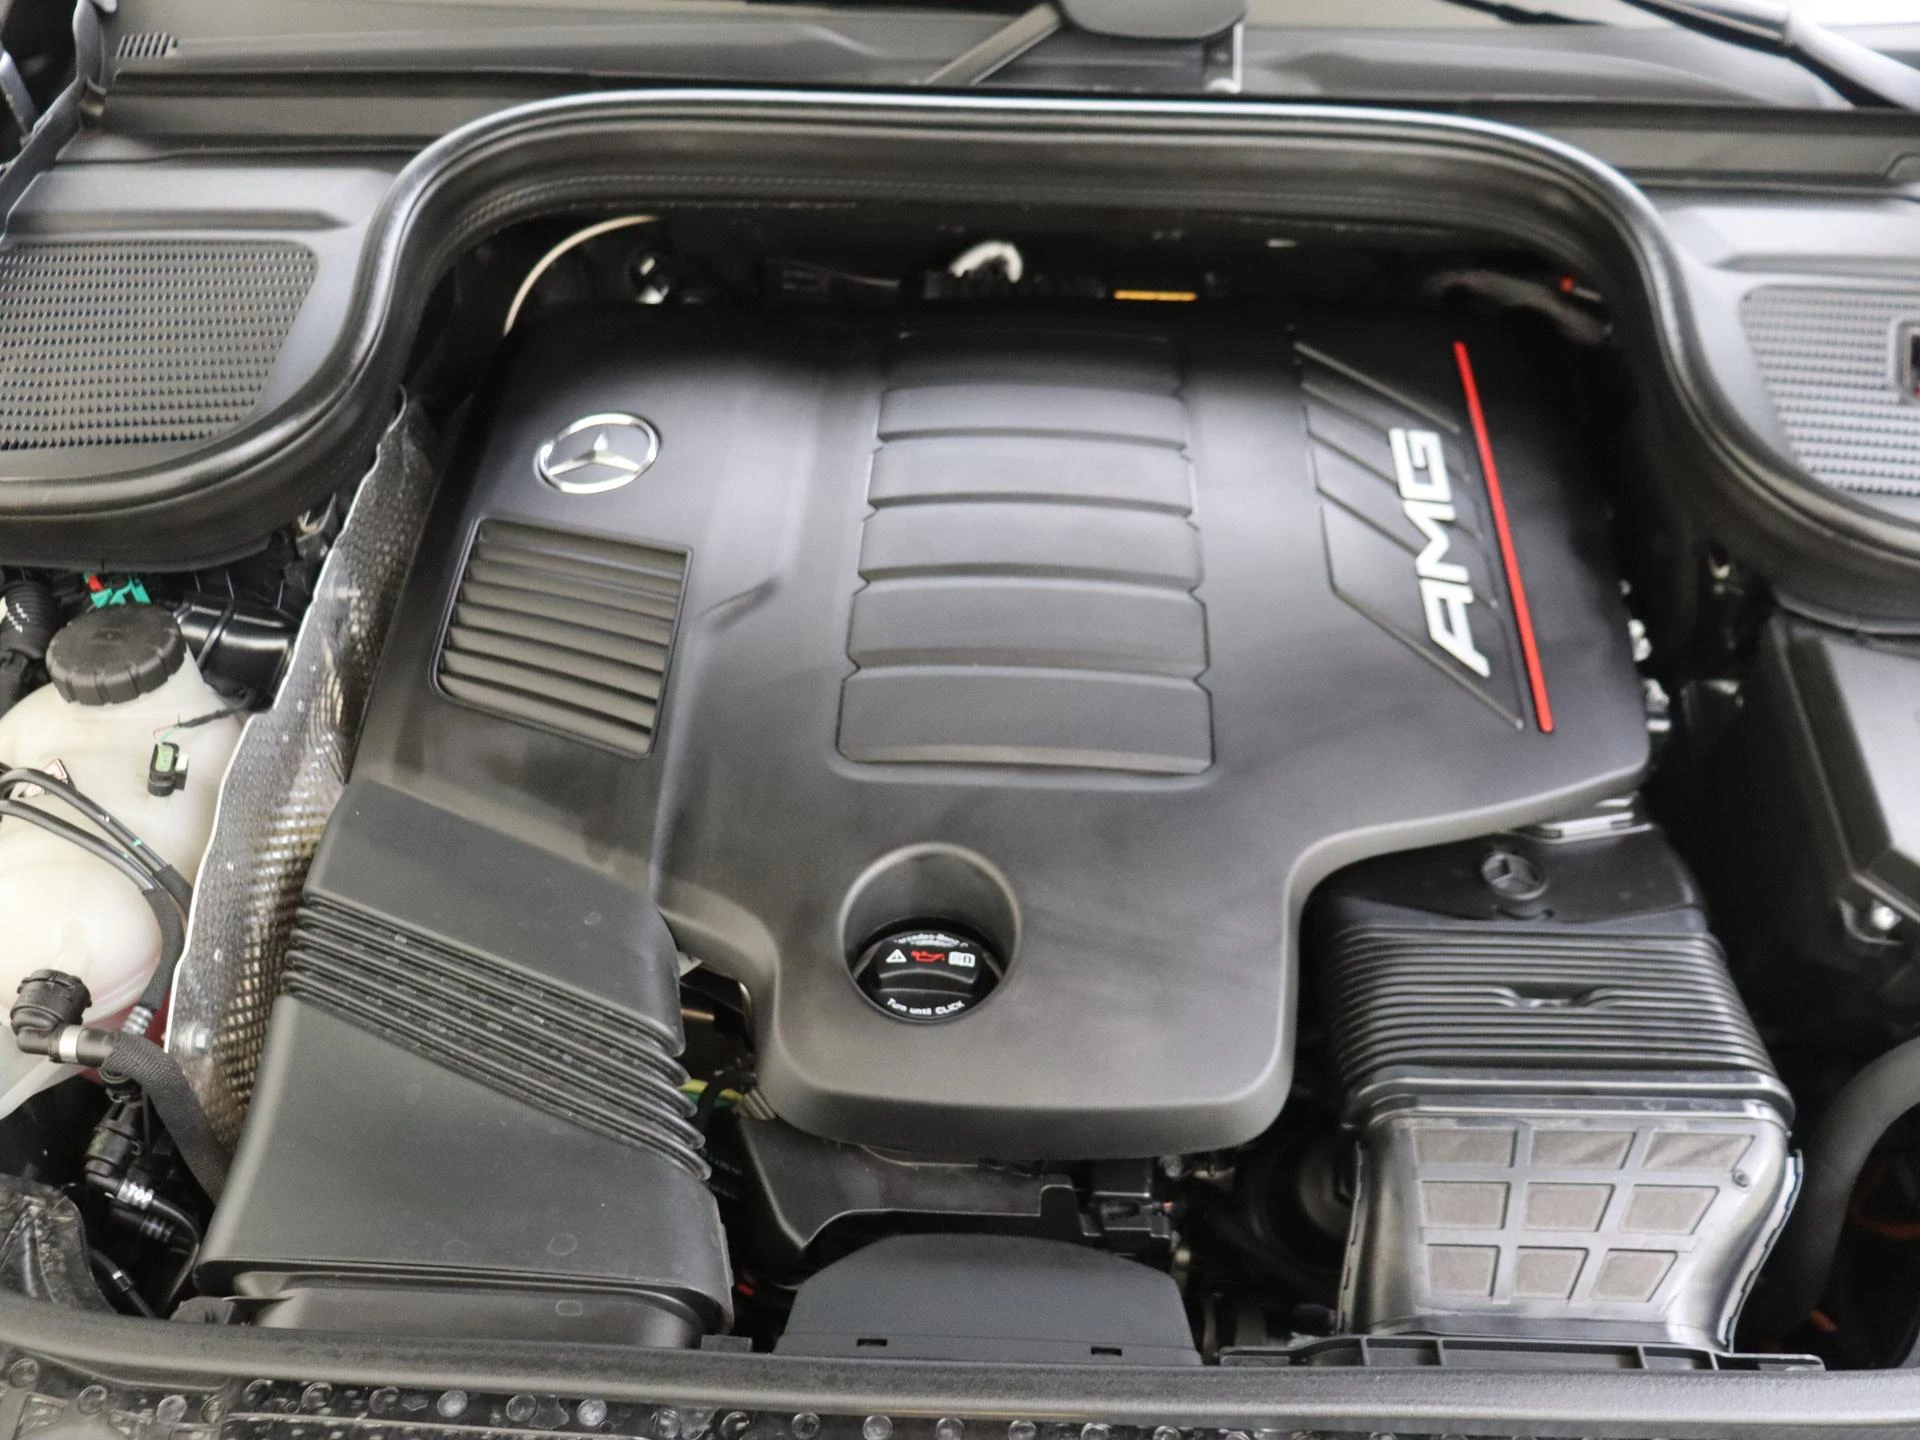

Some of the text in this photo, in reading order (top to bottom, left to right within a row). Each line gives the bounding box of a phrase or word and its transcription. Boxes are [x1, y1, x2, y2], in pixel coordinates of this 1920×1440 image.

[1389, 427, 1490, 678] AMG
[887, 998, 966, 1016] Turn until CLICK
